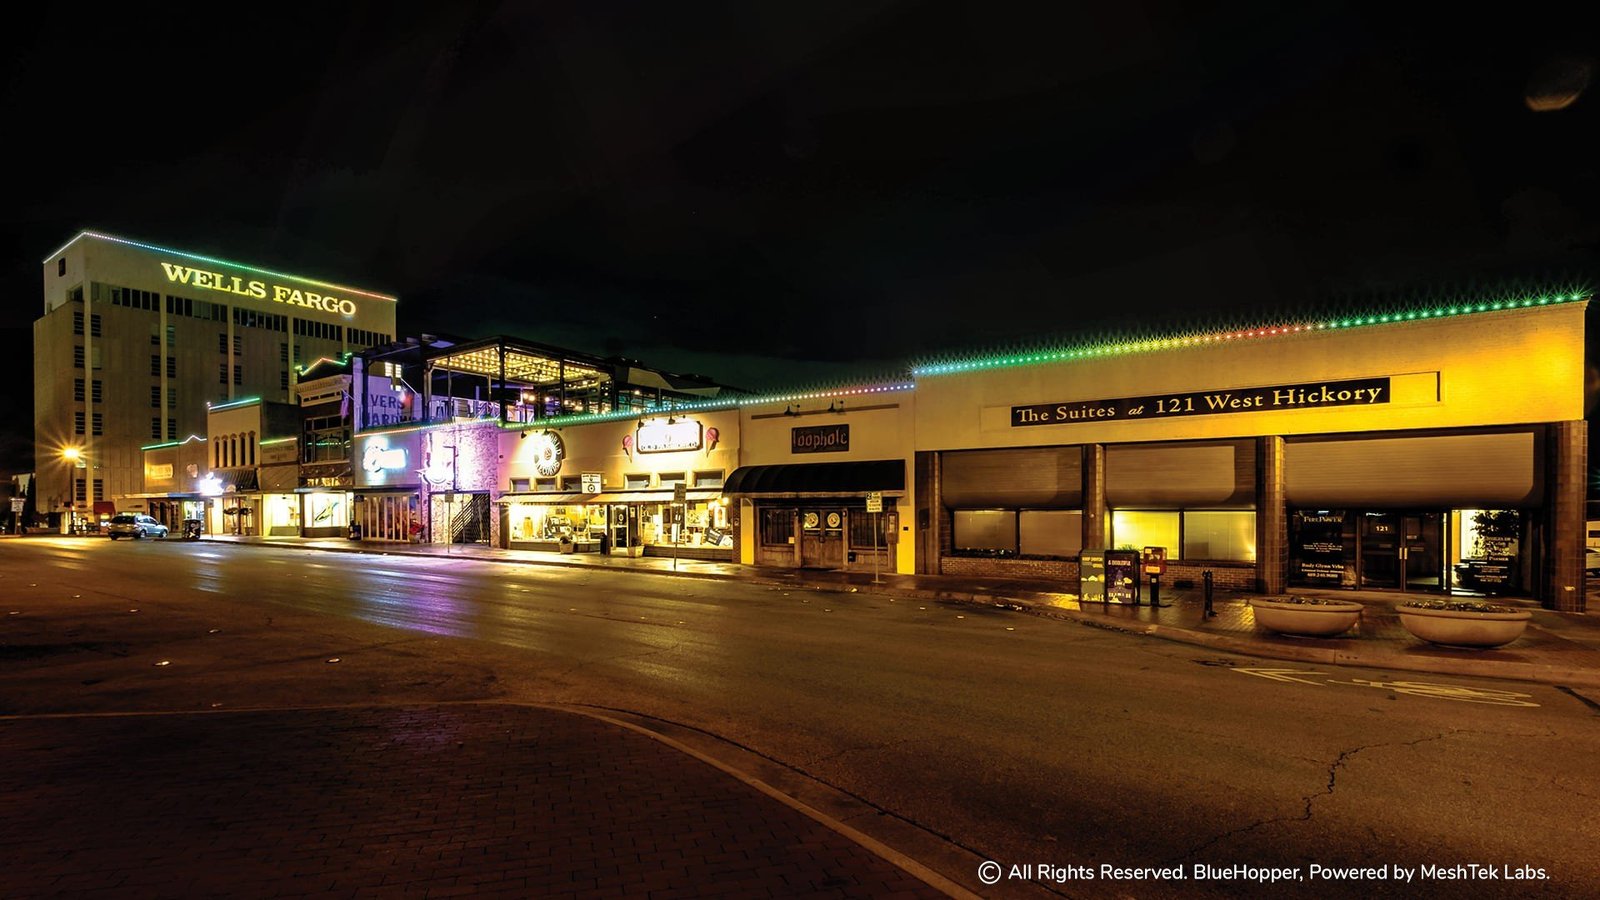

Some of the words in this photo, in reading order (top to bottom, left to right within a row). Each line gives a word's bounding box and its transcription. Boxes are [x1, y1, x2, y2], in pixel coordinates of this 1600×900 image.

[161, 263, 266, 299] WELLS
[273, 285, 356, 315] FARGO
[1016, 409, 1049, 423] The
[1056, 406, 1115, 421] Suites
[1128, 405, 1144, 415] at
[1156, 398, 1194, 414] 121
[1205, 394, 1263, 410] West
[1273, 386, 1382, 408] Hickory
